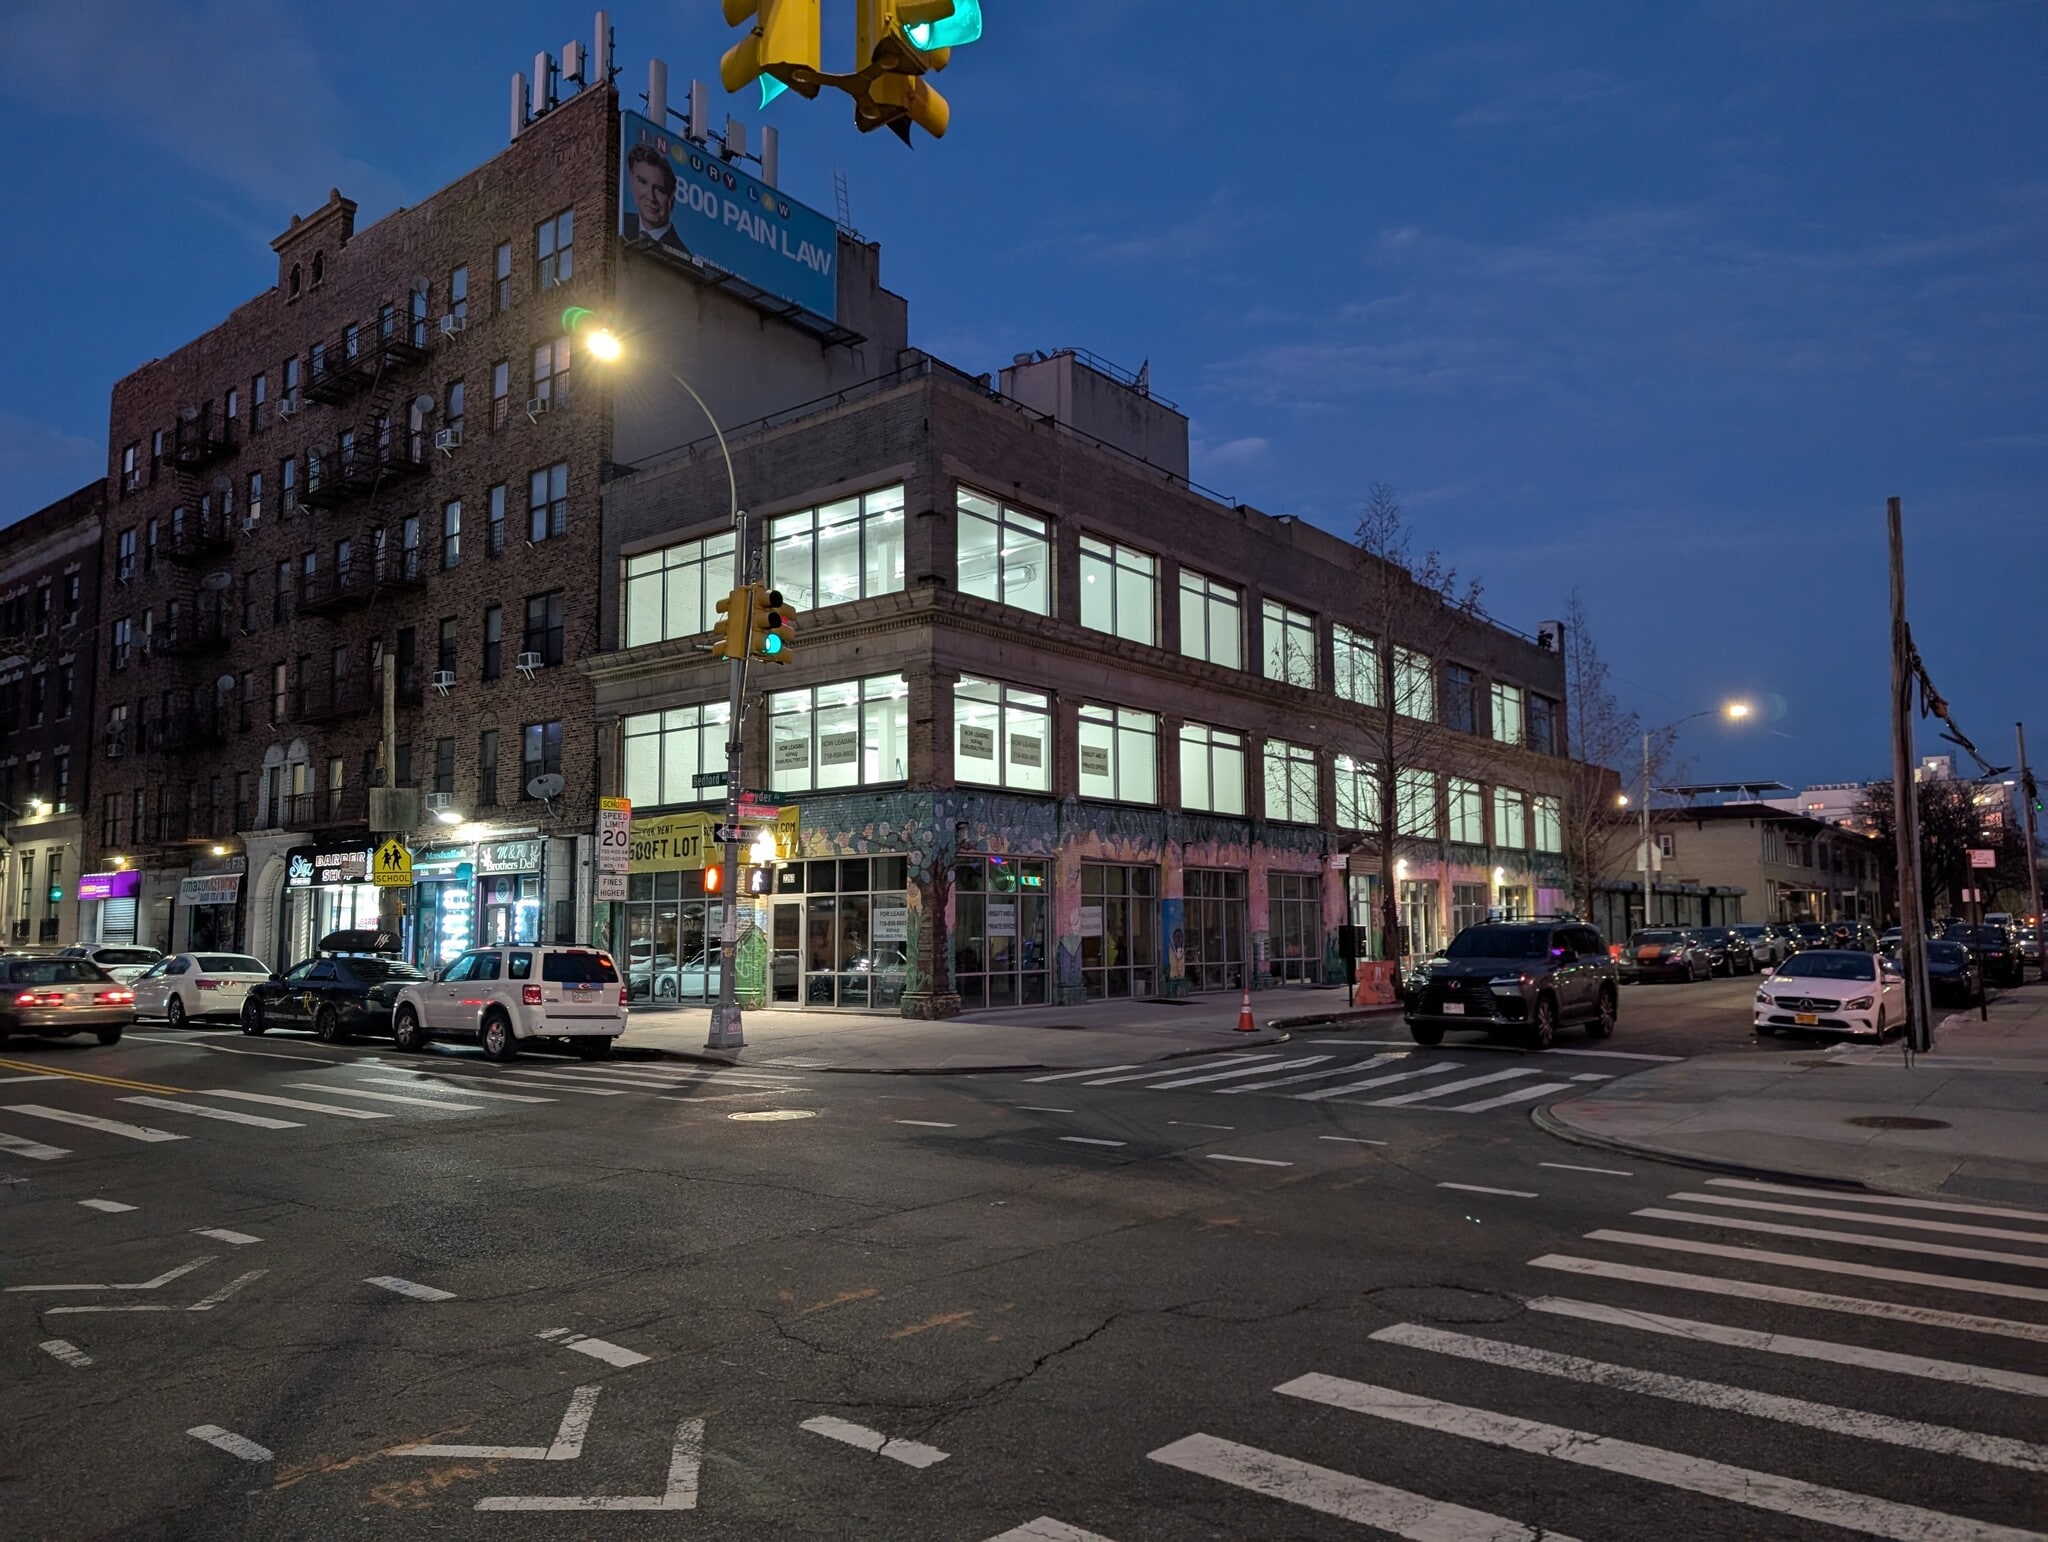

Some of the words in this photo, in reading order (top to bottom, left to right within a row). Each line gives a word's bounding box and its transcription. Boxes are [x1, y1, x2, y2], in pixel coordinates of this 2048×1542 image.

[723, 198, 777, 251] PAIN
[782, 230, 832, 276] LAW
[834, 737, 856, 746] LEASING
[693, 774, 720, 787] Bedford
[602, 800, 629, 810] SCHOOL
[602, 812, 629, 820] SPEED
[604, 821, 625, 829] LIMIT
[642, 827, 655, 837] FOR
[657, 824, 674, 835] RENT
[602, 830, 627, 847] 20
[721, 829, 734, 838] ONE
[673, 836, 699, 858] LOT
[315, 852, 366, 867] BARBER
[486, 860, 518, 872] Brothers
[519, 857, 536, 870] Deli
[376, 873, 410, 884] SCHOOL
[602, 878, 623, 887] FINES
[600, 889, 626, 898] HIGHER
